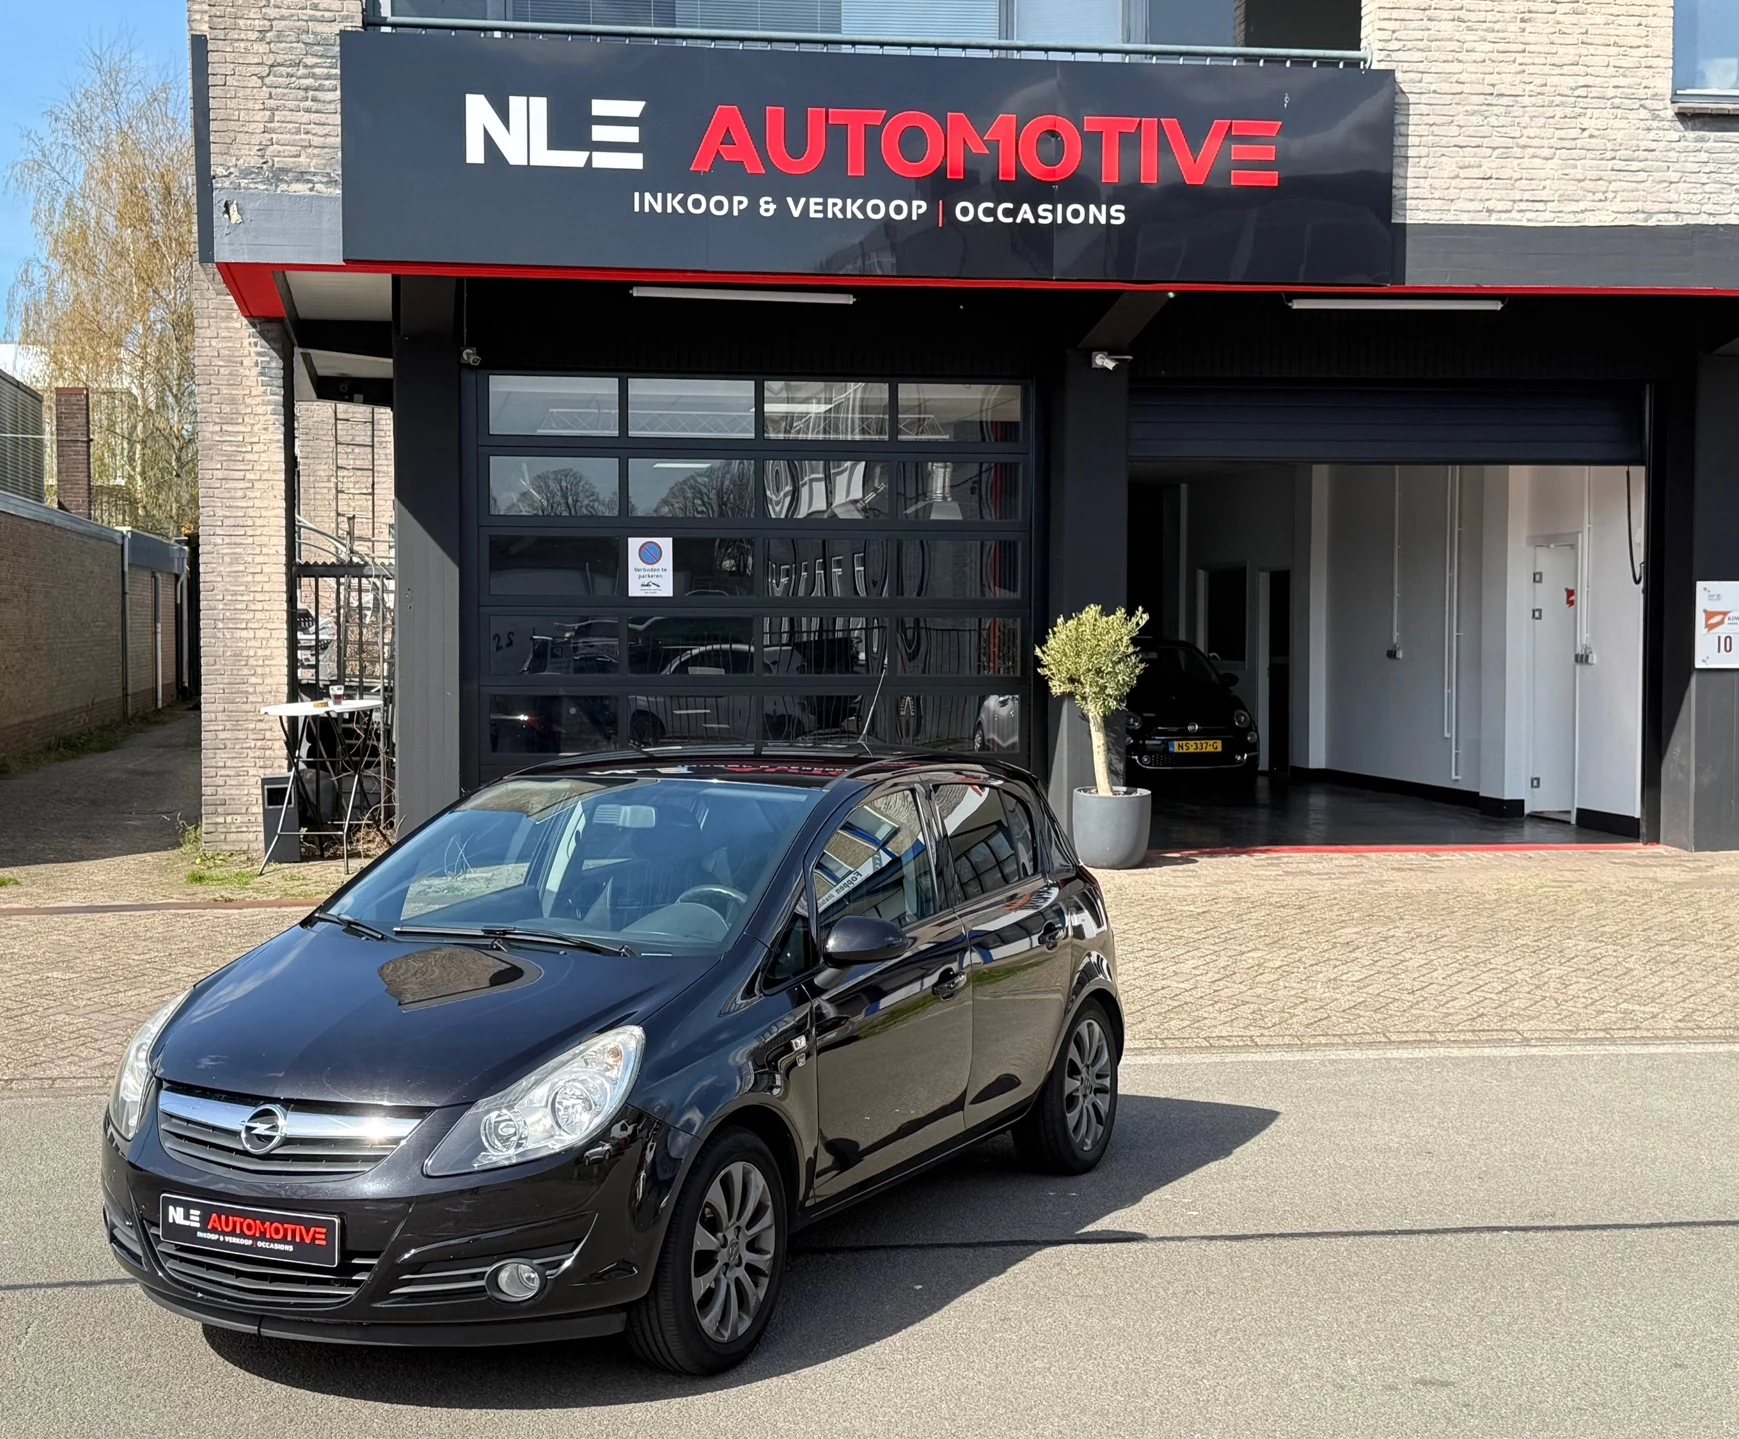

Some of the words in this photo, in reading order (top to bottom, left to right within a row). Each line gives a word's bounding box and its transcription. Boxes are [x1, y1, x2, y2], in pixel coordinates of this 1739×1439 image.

[465, 93, 646, 170] NLE
[690, 105, 1283, 187] AUTOMOTIVE
[632, 191, 749, 217] INKOOP
[758, 196, 777, 218] &
[787, 196, 928, 222] VERKOOP
[955, 201, 1127, 226] OCCASIONS
[168, 1205, 201, 1228] NLE
[207, 1213, 327, 1246] AUTOMOTIVE
[196, 1231, 219, 1241] INKOOP
[225, 1236, 252, 1246] VERKOOP
[257, 1241, 293, 1251] OCCASIONS
